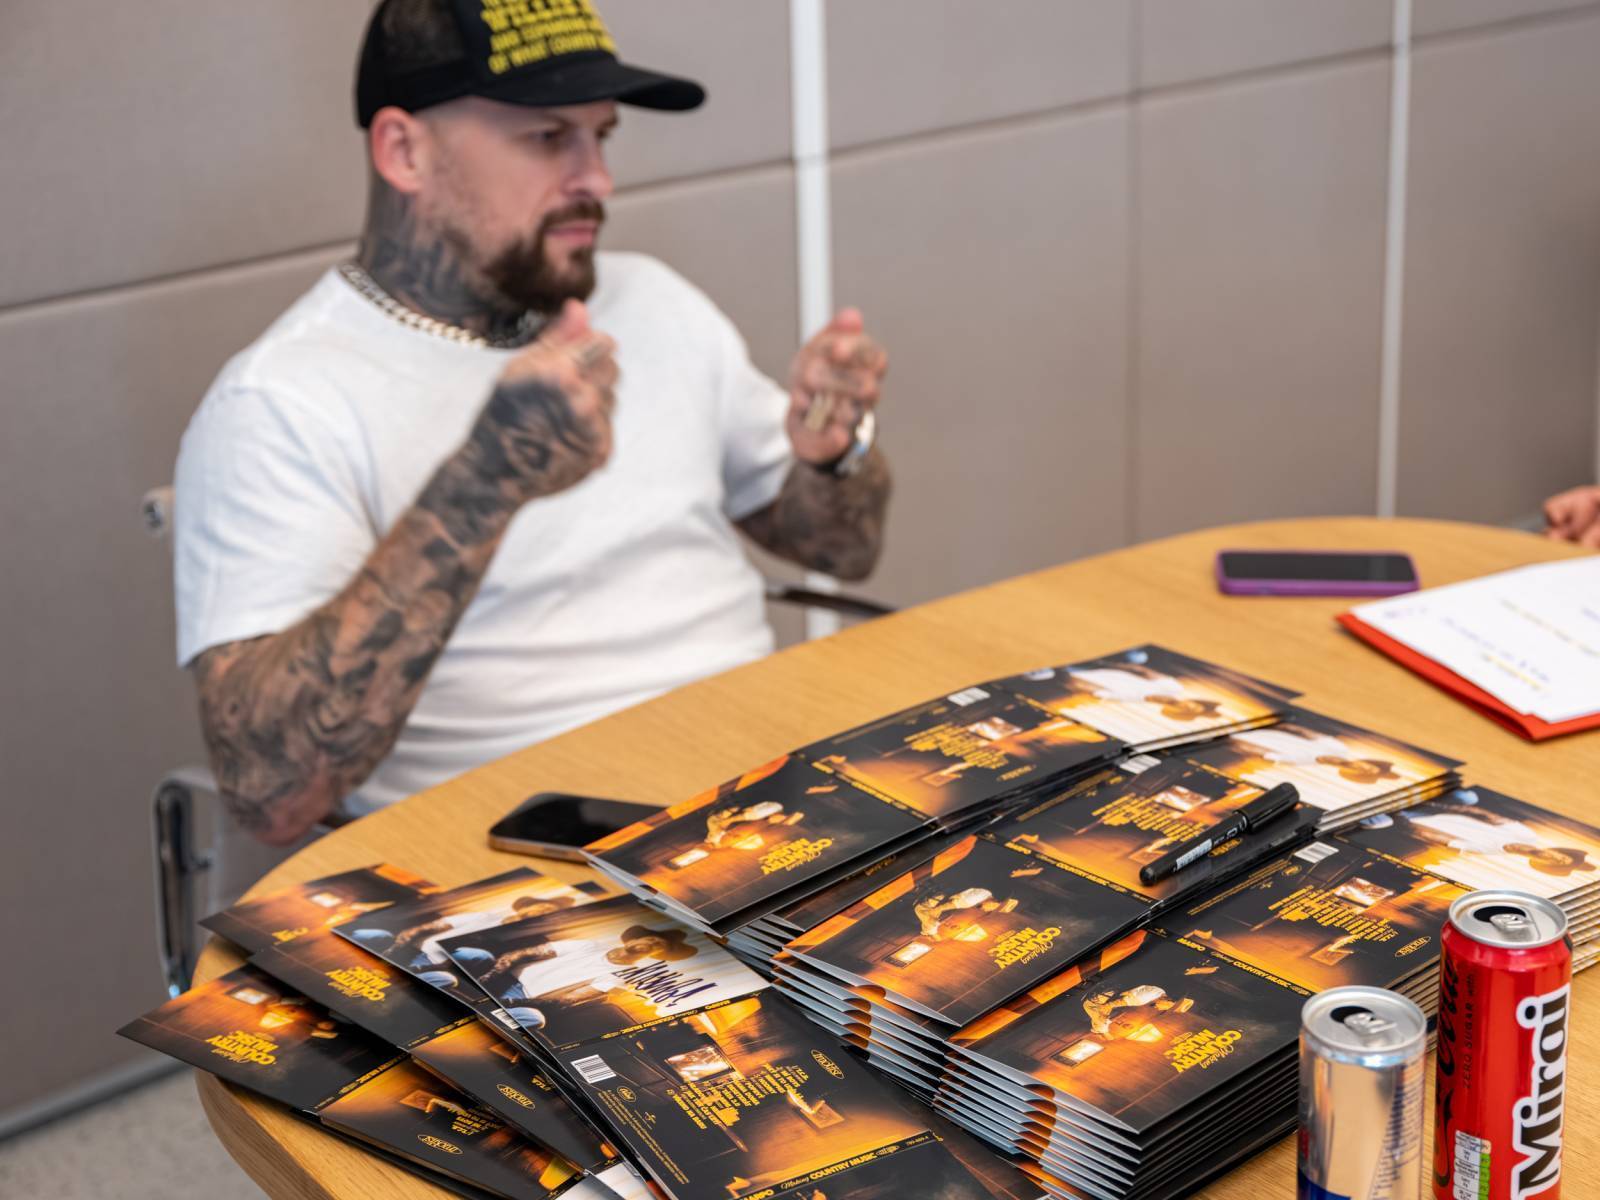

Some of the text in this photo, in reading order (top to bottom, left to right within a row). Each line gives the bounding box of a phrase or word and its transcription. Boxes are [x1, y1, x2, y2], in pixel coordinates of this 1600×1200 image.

[758, 837, 810, 864] MUSIC
[759, 838, 832, 875] COUNTRY
[1054, 860, 1088, 878] COUNTRY
[986, 926, 1037, 958] MUSIC
[992, 927, 1062, 970] COUNTRY
[1019, 940, 1054, 965] Making
[345, 965, 391, 989] MUSIC
[1176, 935, 1207, 953] MARPO
[1232, 958, 1267, 979] COUNTRY
[1265, 973, 1291, 988] MUSIC
[323, 968, 385, 1001] COUNTRY
[619, 1023, 643, 1034] MUSIC
[642, 1014, 675, 1027] COUNTRY
[1464, 1003, 1475, 1048] SUGAR
[204, 1034, 276, 1065] COUNTRY
[226, 1029, 278, 1053] MUSIC
[1162, 1027, 1217, 1060] MUSIC
[1170, 1030, 1241, 1073] COUNTRY
[1198, 1043, 1233, 1070] Making
[1463, 1053, 1473, 1089] ZERO
[1516, 988, 1569, 1197] Mirai
[779, 1174, 810, 1191] Making
[808, 1161, 851, 1181] COUNTRY
[848, 1151, 878, 1167] MUSIC
